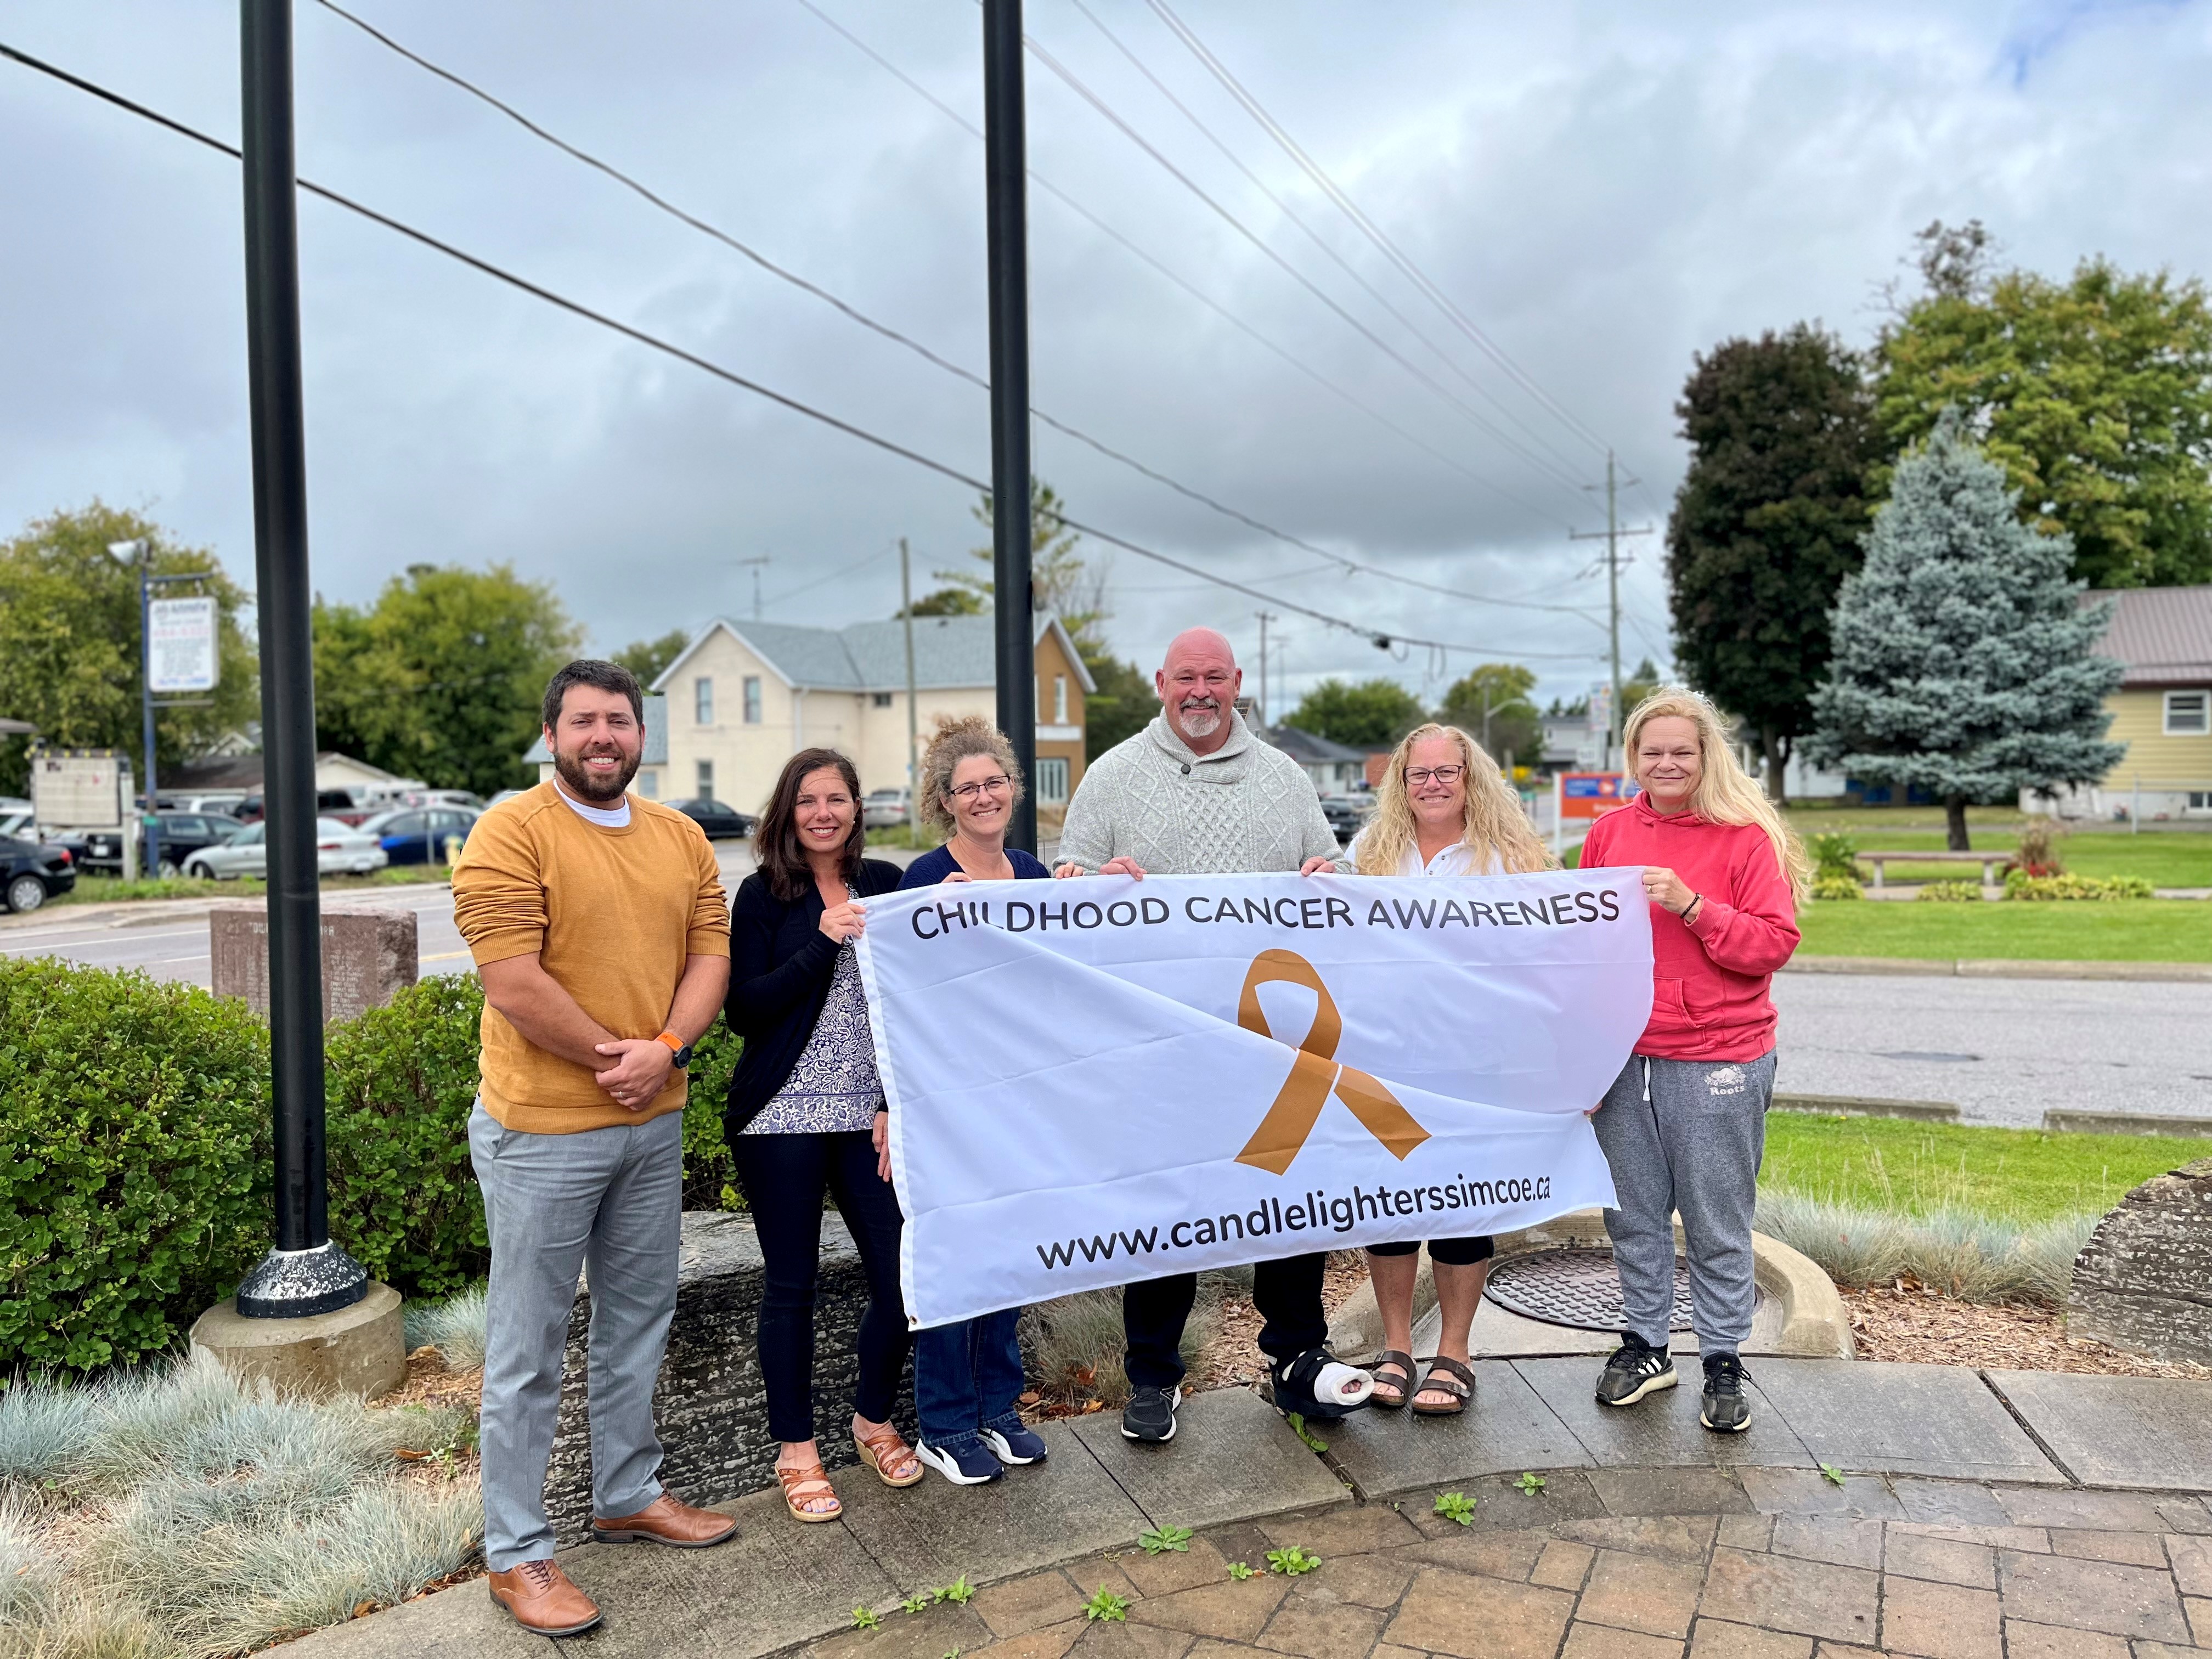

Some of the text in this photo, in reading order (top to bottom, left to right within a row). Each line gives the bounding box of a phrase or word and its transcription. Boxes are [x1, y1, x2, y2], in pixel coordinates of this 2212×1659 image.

[912, 890, 1619, 939] CHILDHOOD CANCER AWARENESS
[1709, 1085, 1745, 1096] Roots
[1036, 1173, 1551, 1269] www.candlelighterssimcoe.ca
